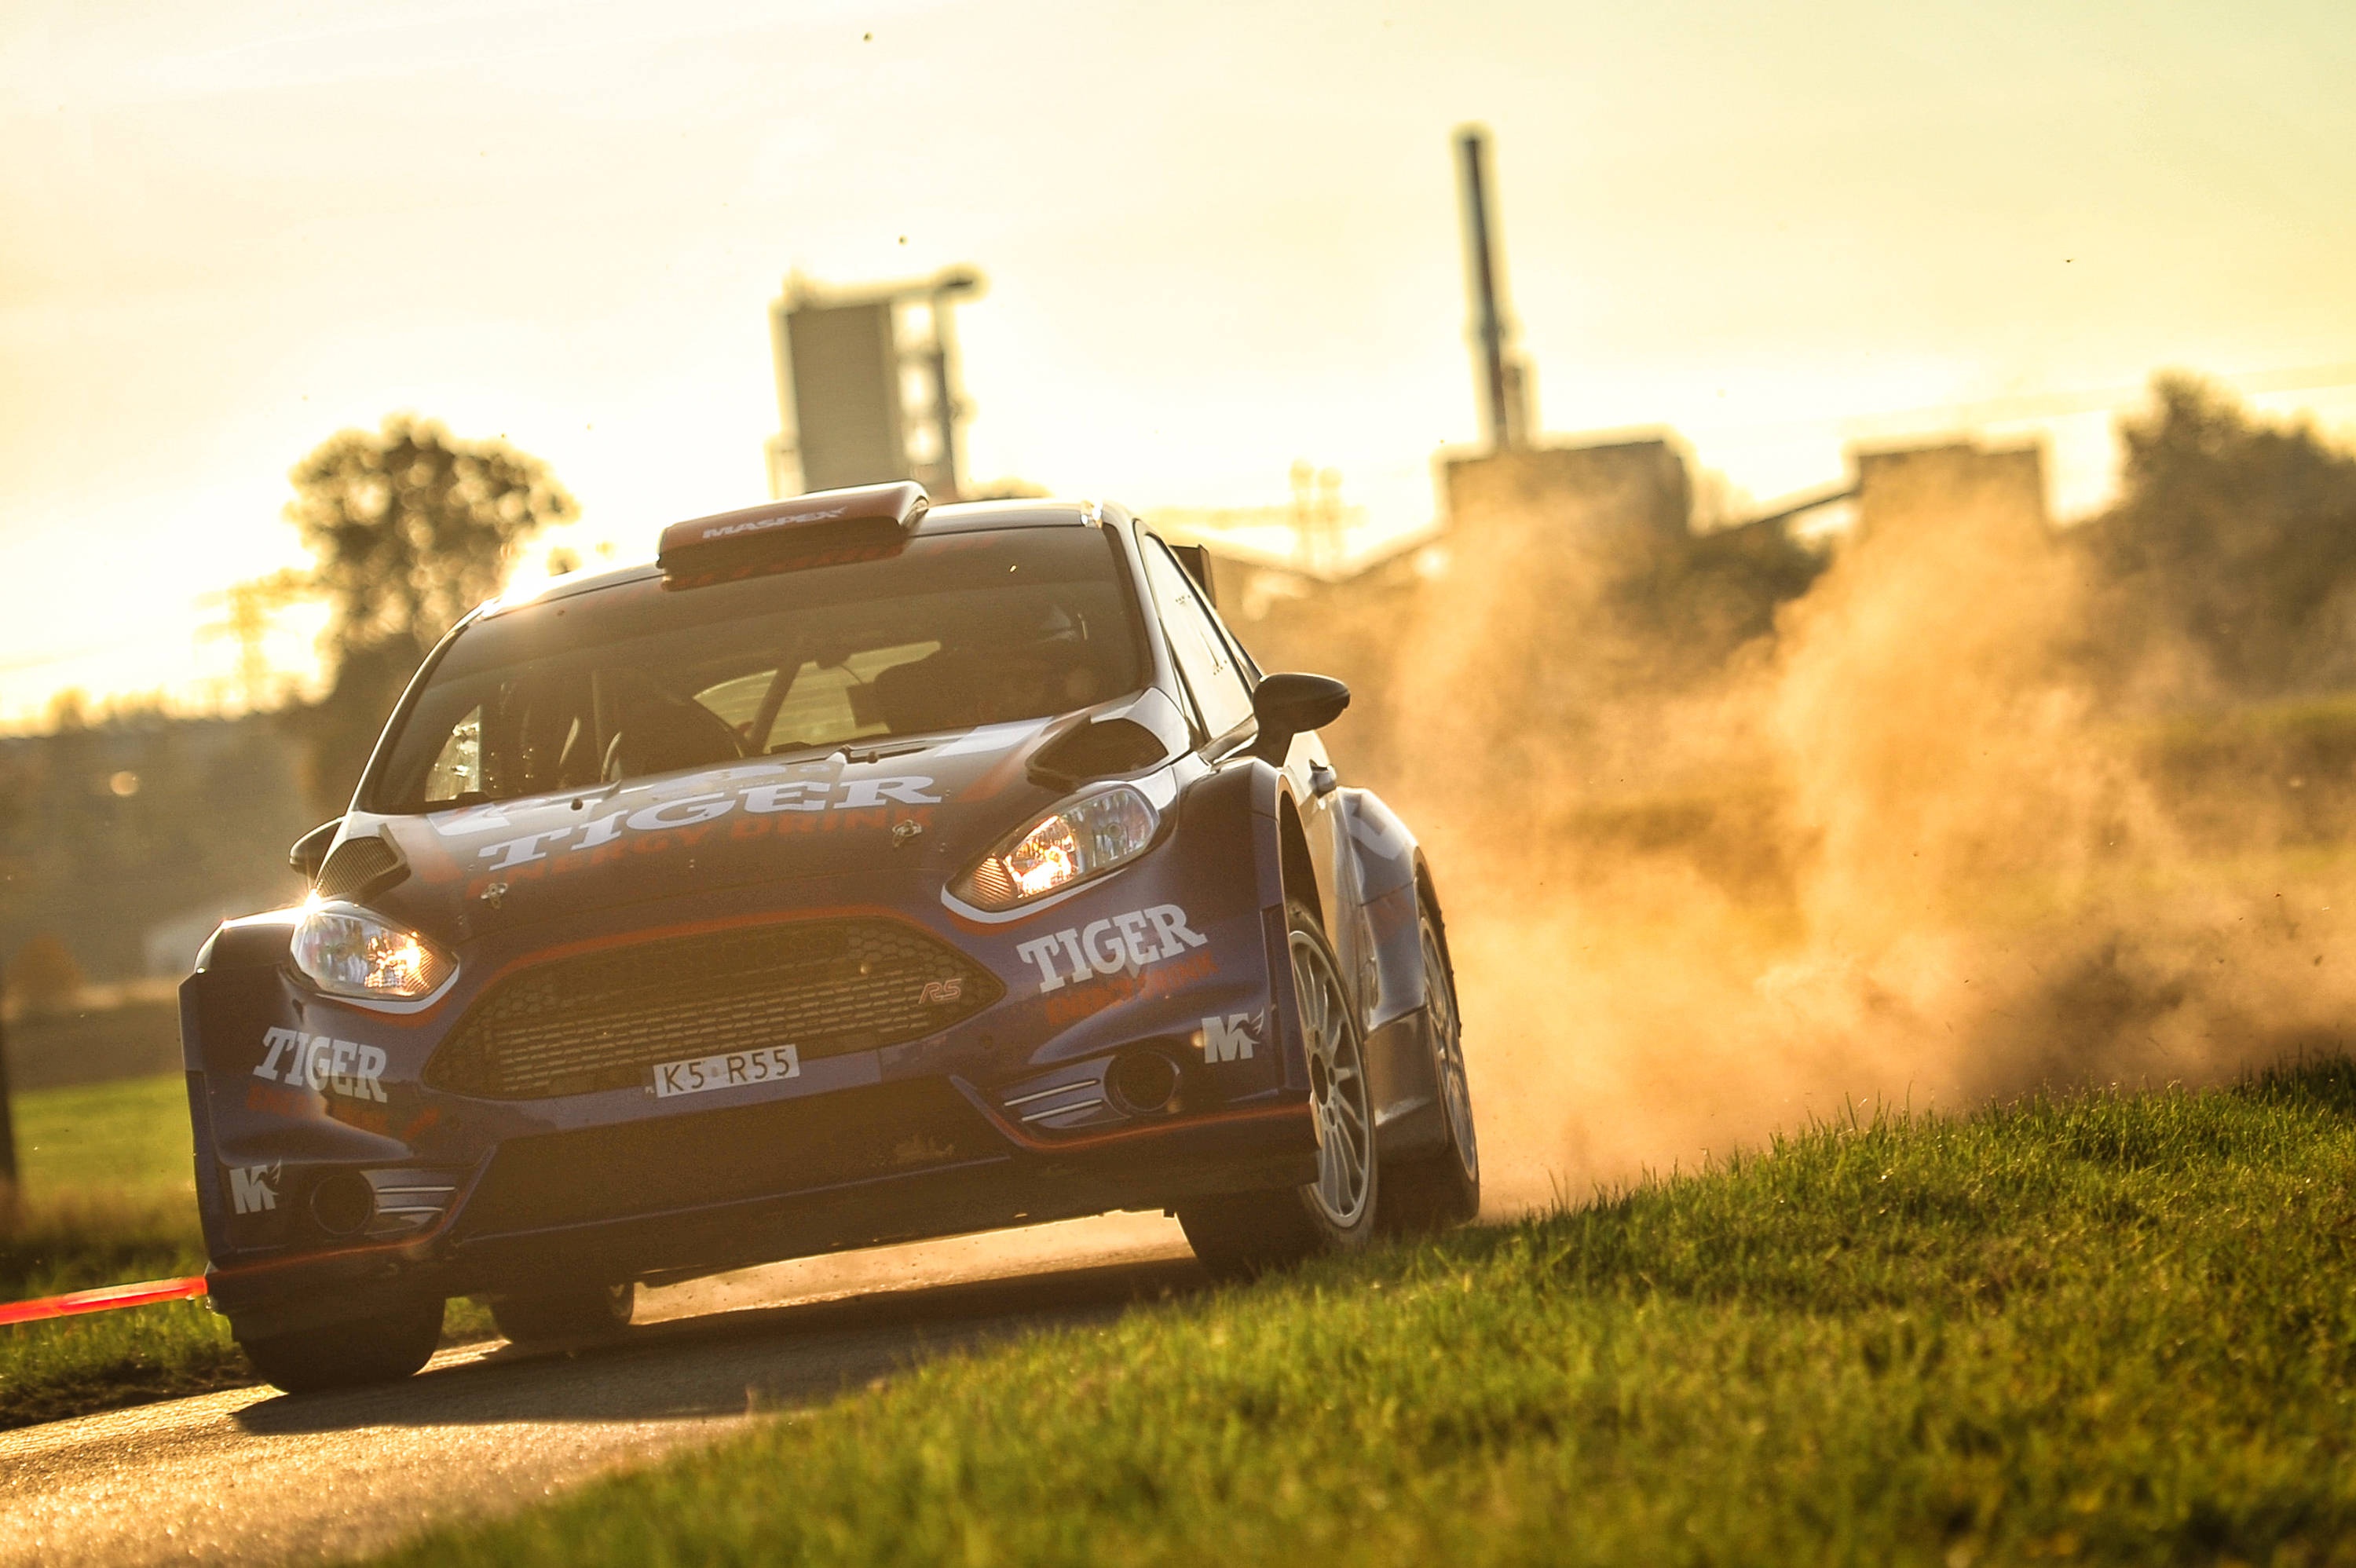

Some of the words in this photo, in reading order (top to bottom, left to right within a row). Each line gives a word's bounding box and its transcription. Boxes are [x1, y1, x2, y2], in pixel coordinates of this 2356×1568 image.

[703, 506, 847, 539] MASPEX
[477, 776, 942, 871] TIGER
[730, 805, 936, 841] DRINK
[1016, 904, 1208, 993] TIGER
[918, 978, 961, 1004] RS
[252, 1026, 387, 1103] TIGER
[664, 1062, 704, 1094] K5
[726, 1048, 790, 1084] R55
